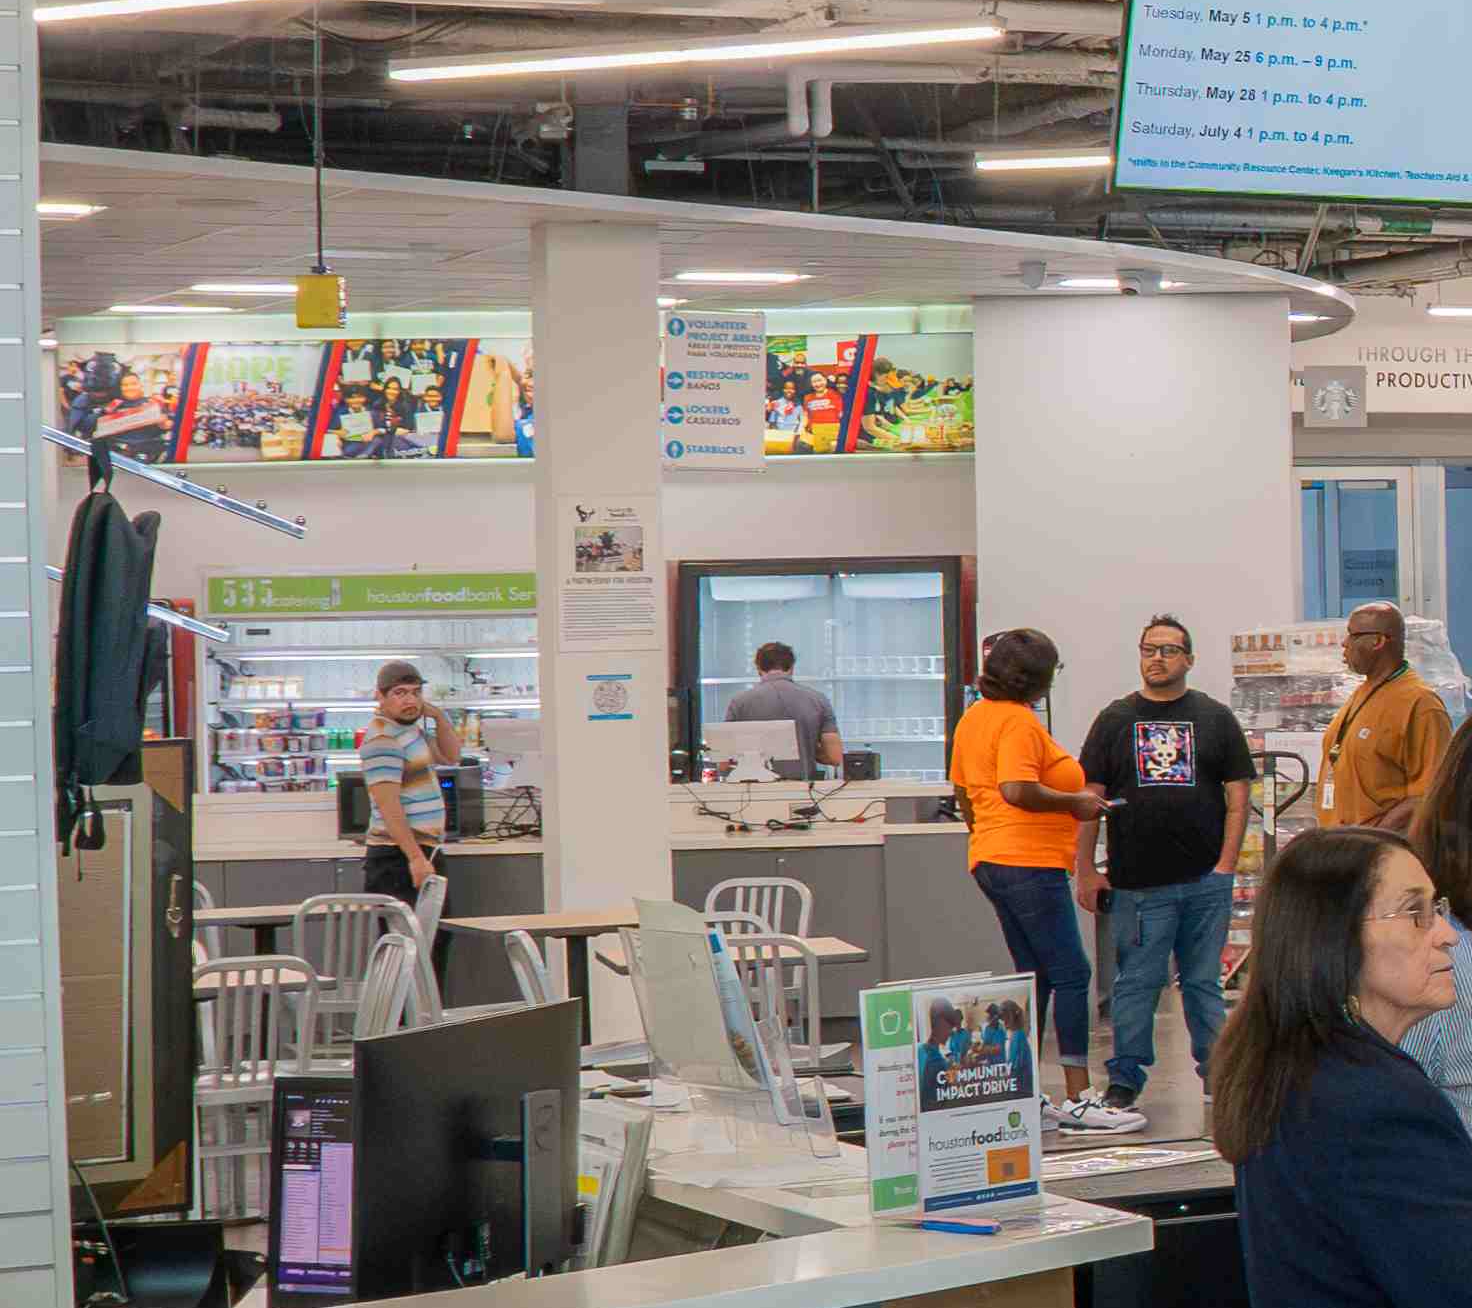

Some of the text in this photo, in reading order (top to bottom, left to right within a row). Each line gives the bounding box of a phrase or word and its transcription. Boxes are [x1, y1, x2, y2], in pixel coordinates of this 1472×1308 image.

[1144, 4, 1204, 22] Tuesday,
[1208, 9, 1239, 26] May
[1242, 11, 1251, 24] 5
[1255, 12, 1262, 25] 1
[1267, 15, 1298, 29] p.m.
[1302, 16, 1316, 29] to
[1320, 17, 1328, 29] 4
[1138, 43, 1196, 62] Monday,
[1200, 47, 1230, 65] May
[1234, 50, 1251, 63] 25
[1255, 51, 1264, 64] 6
[1268, 53, 1299, 67] p.m.
[1314, 55, 1323, 67] 9
[1327, 57, 1357, 71] p.m.
[1136, 81, 1367, 110] Thursday, May 28 1 p.m. to 4 p.m.
[1131, 120, 1354, 147] Saturday, July 4 1 p.m. to 4 p.m.
[687, 320, 748, 330] VOLUNTEER
[1357, 346, 1446, 363] THROUGH
[687, 371, 750, 380] RESTROOMS
[687, 405, 730, 414] LOCKERS
[687, 444, 745, 455] STARBUCKS
[936, 1062, 1013, 1085] CMMUNITY
[936, 1083, 980, 1102] IMPACT
[981, 1078, 1018, 1096] DRIVE
[928, 1125, 1030, 1152] houstonfoodbank
